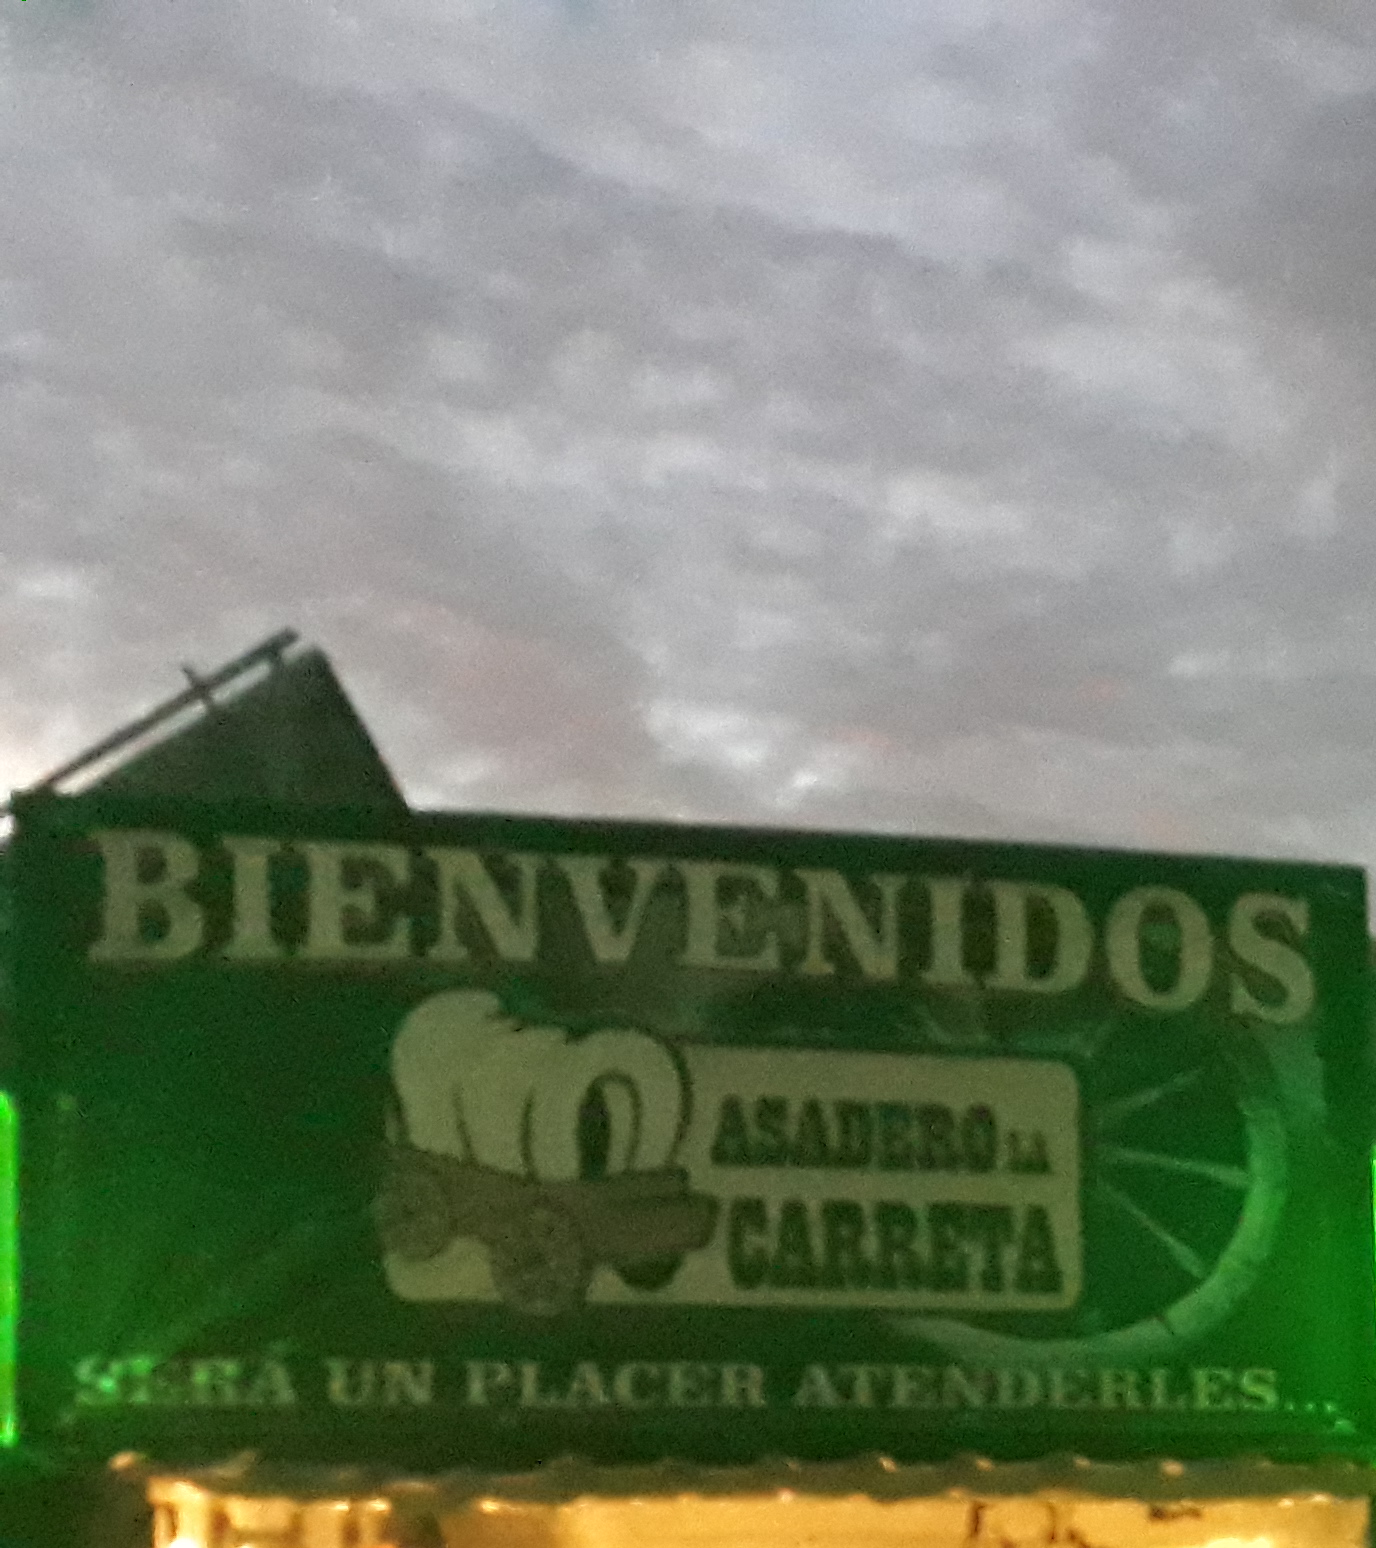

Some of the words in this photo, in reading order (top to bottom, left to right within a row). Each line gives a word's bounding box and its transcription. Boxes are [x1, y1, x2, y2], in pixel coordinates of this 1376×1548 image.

[87, 827, 1317, 1024] BIENVENIDOS
[710, 1094, 997, 1174] ASADERO
[726, 1194, 1064, 1295] CARRETA
[326, 1358, 436, 1406] UN
[462, 1358, 767, 1408] PLACER
